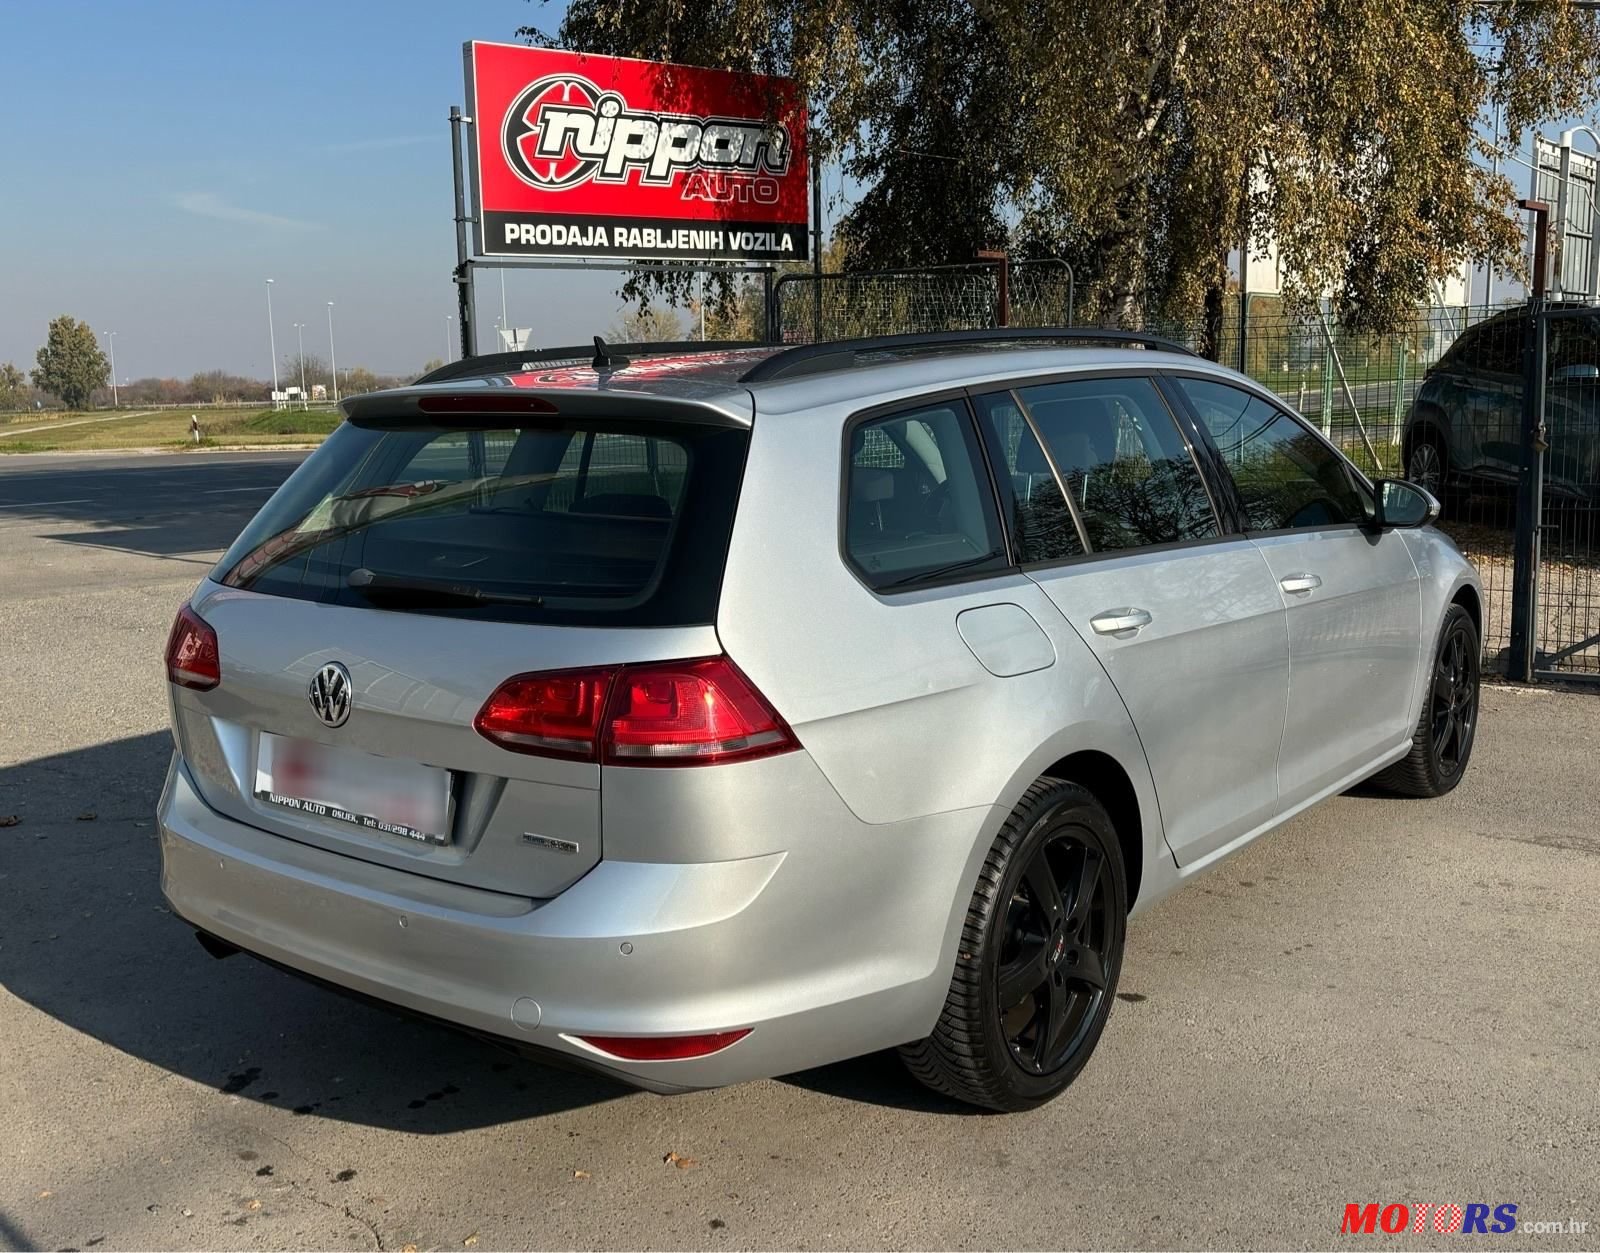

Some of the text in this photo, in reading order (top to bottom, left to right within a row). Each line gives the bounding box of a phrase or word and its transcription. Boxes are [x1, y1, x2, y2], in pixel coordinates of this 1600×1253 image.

[538, 95, 790, 181] nippon
[681, 172, 780, 203] AUTO
[505, 223, 794, 252] PRODAJA RABLJENIH VOZILA
[269, 793, 300, 808] NIPPON
[302, 801, 326, 815] AUTO
[363, 817, 376, 828] Tel:
[409, 830, 425, 841] 444
